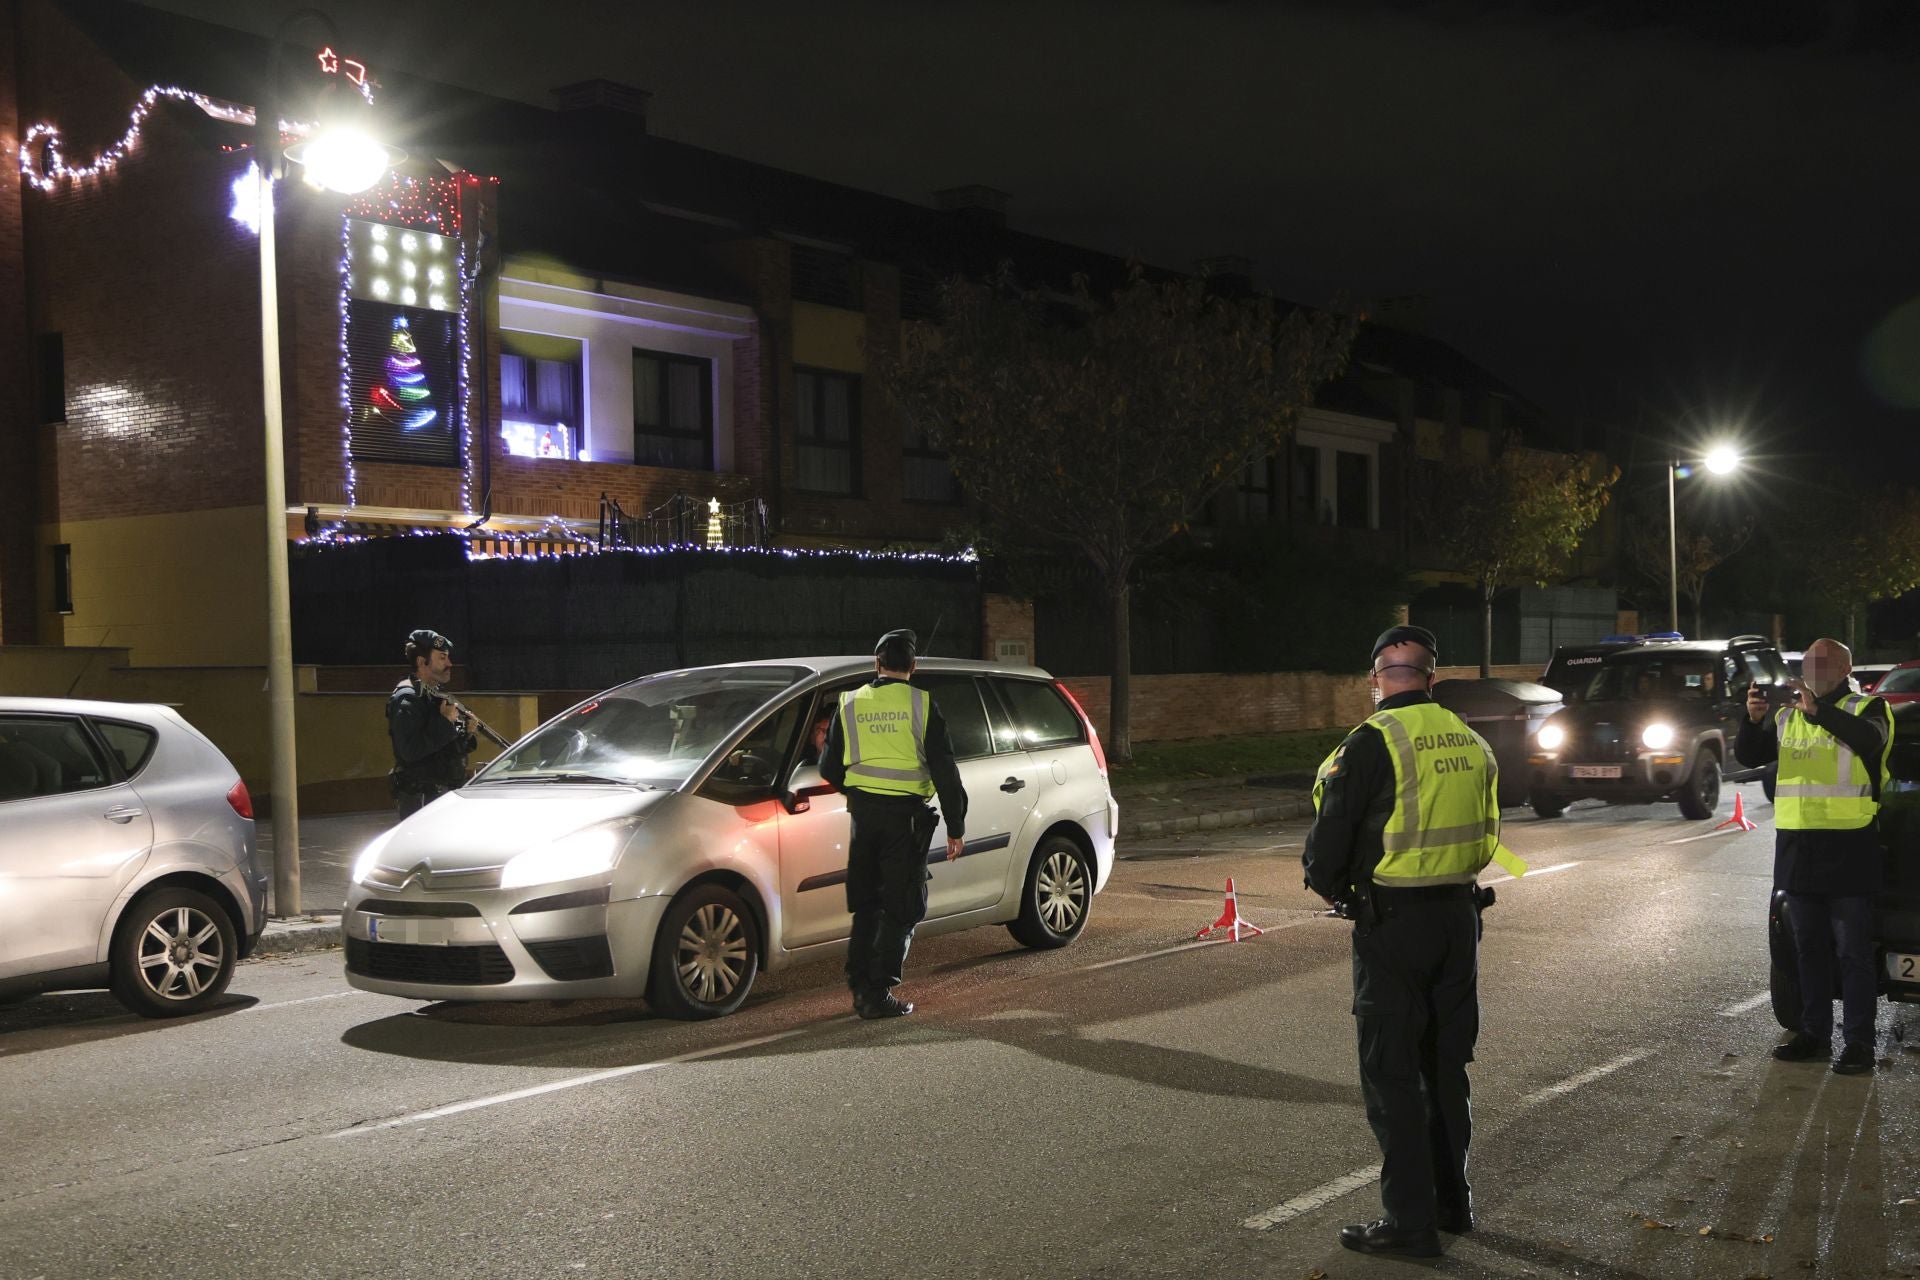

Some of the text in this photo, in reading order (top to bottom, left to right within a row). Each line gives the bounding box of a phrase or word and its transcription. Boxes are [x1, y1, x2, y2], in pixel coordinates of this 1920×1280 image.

[1567, 657, 1602, 665] GUARDIA
[856, 712, 909, 723] GUARDIA
[869, 724, 898, 733] CIVIL
[1414, 733, 1478, 751] GUARDIA
[1434, 756, 1473, 774] CIVIL
